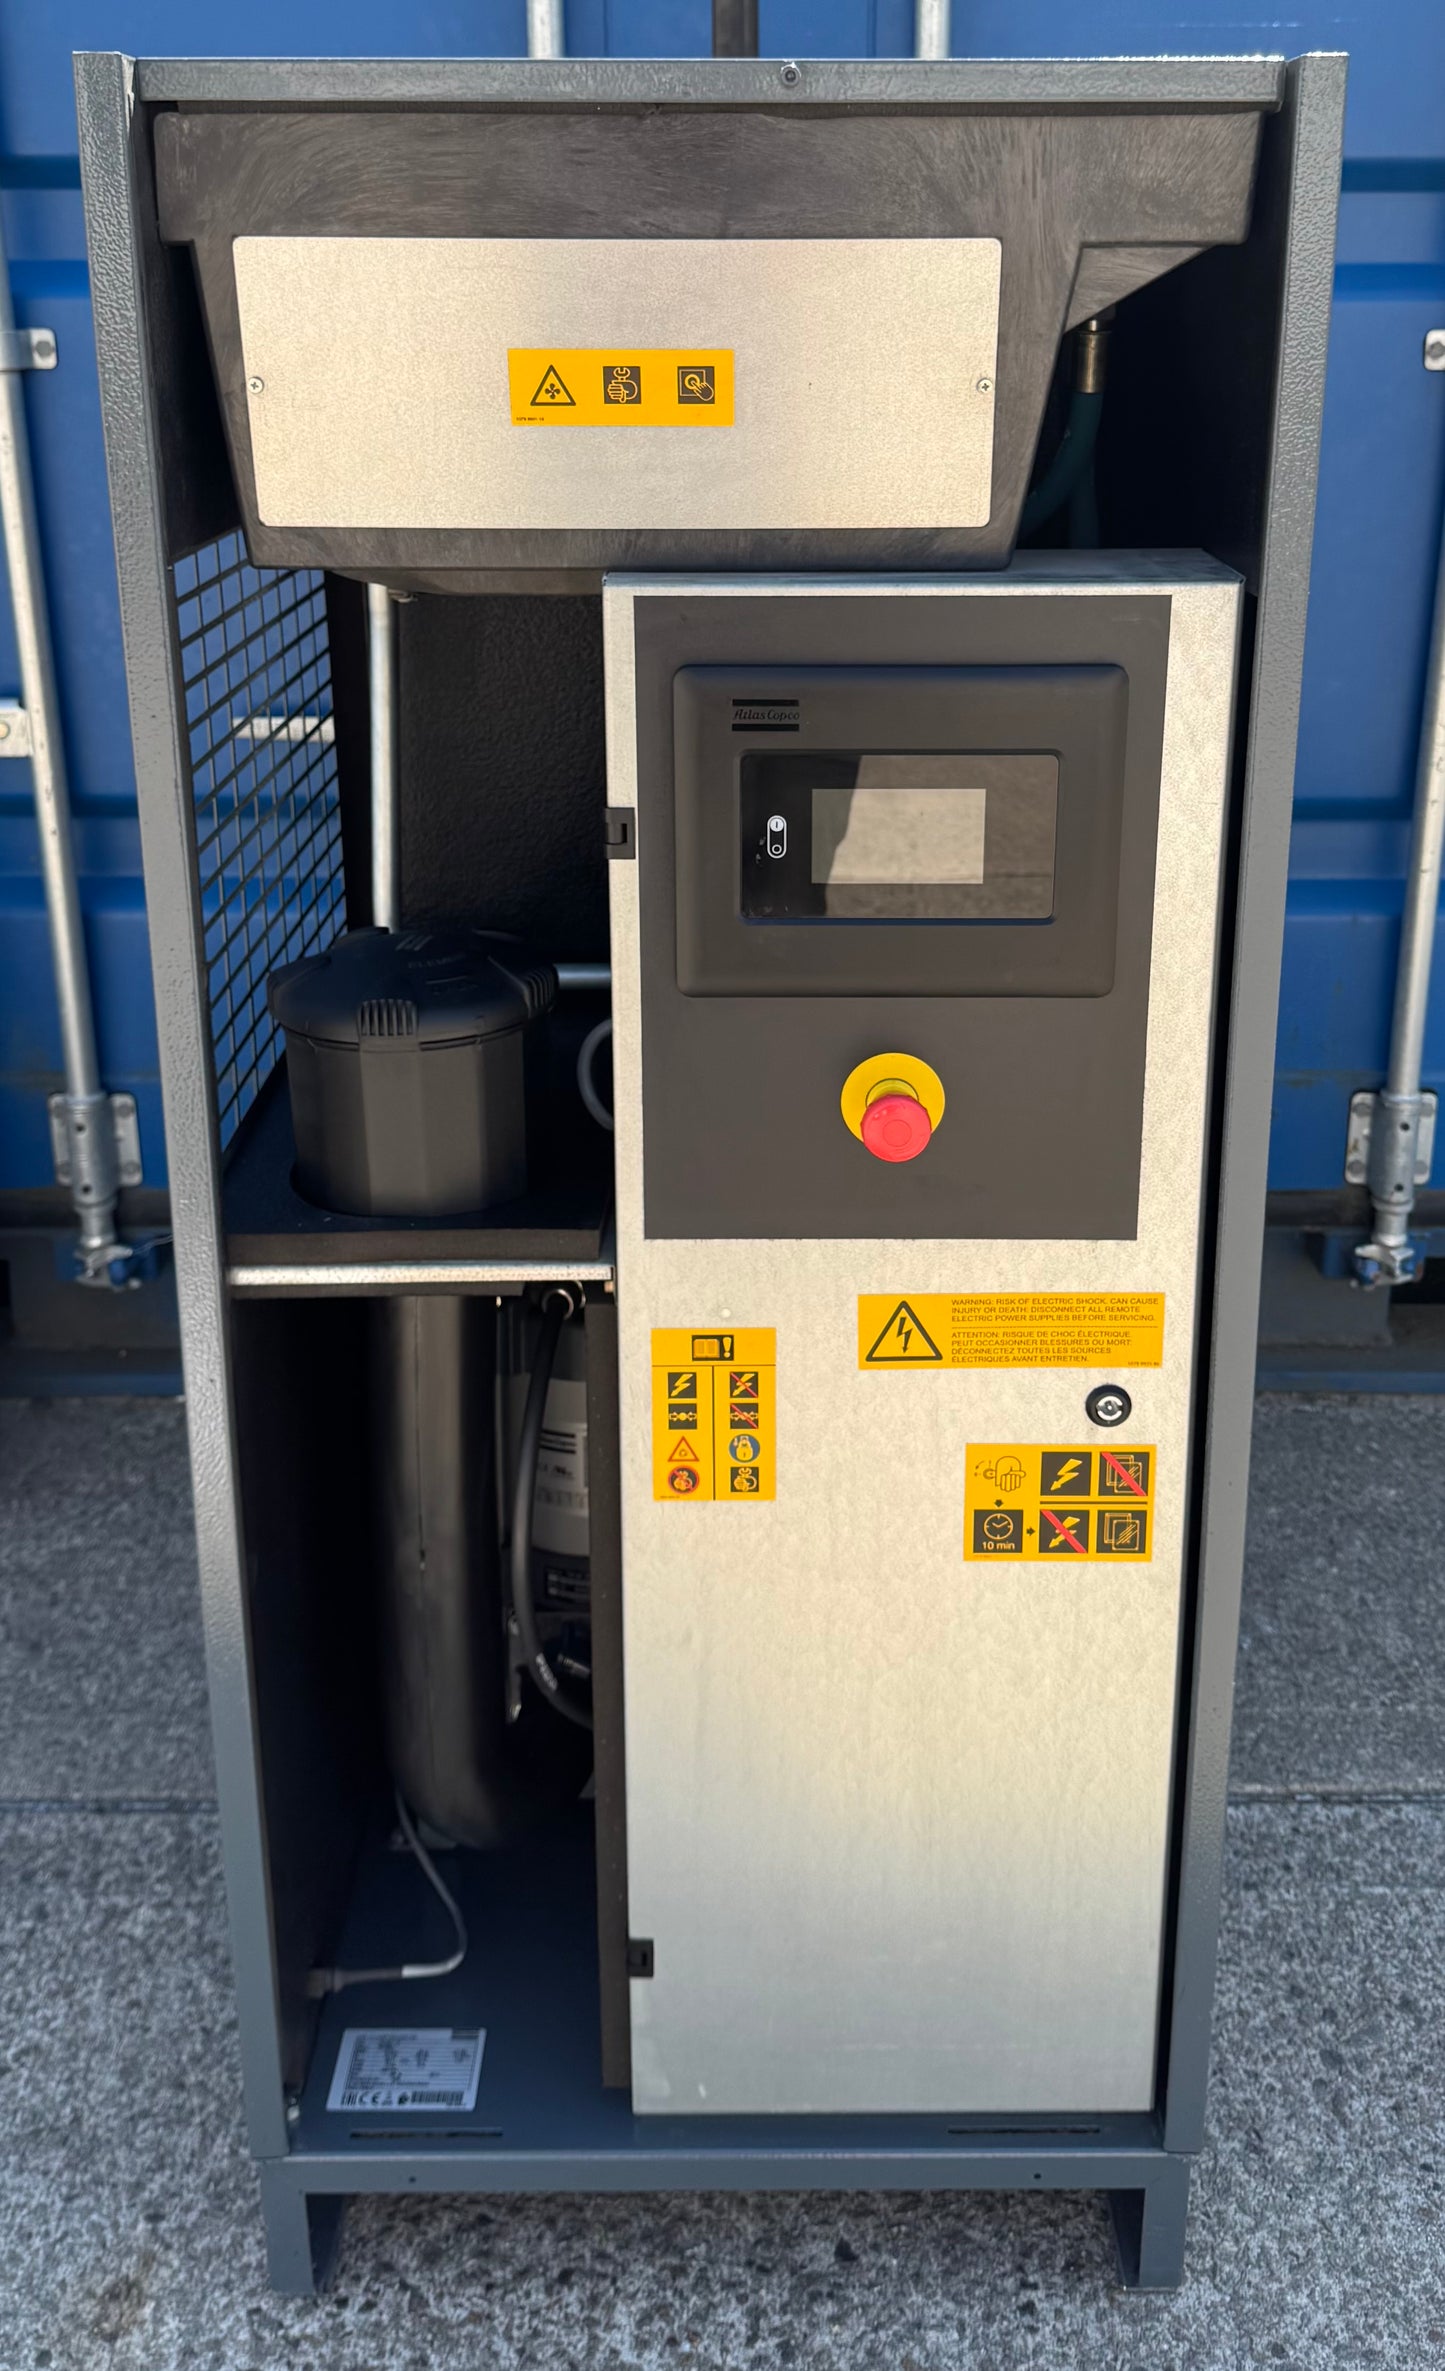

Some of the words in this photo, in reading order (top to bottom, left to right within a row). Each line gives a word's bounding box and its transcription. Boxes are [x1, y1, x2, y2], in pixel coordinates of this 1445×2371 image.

[734, 708, 767, 721] Atlas
[767, 708, 800, 722] Copco
[951, 1339, 974, 1347] PEUT
[982, 1541, 994, 1550] 10
[996, 1541, 1015, 1550] min
